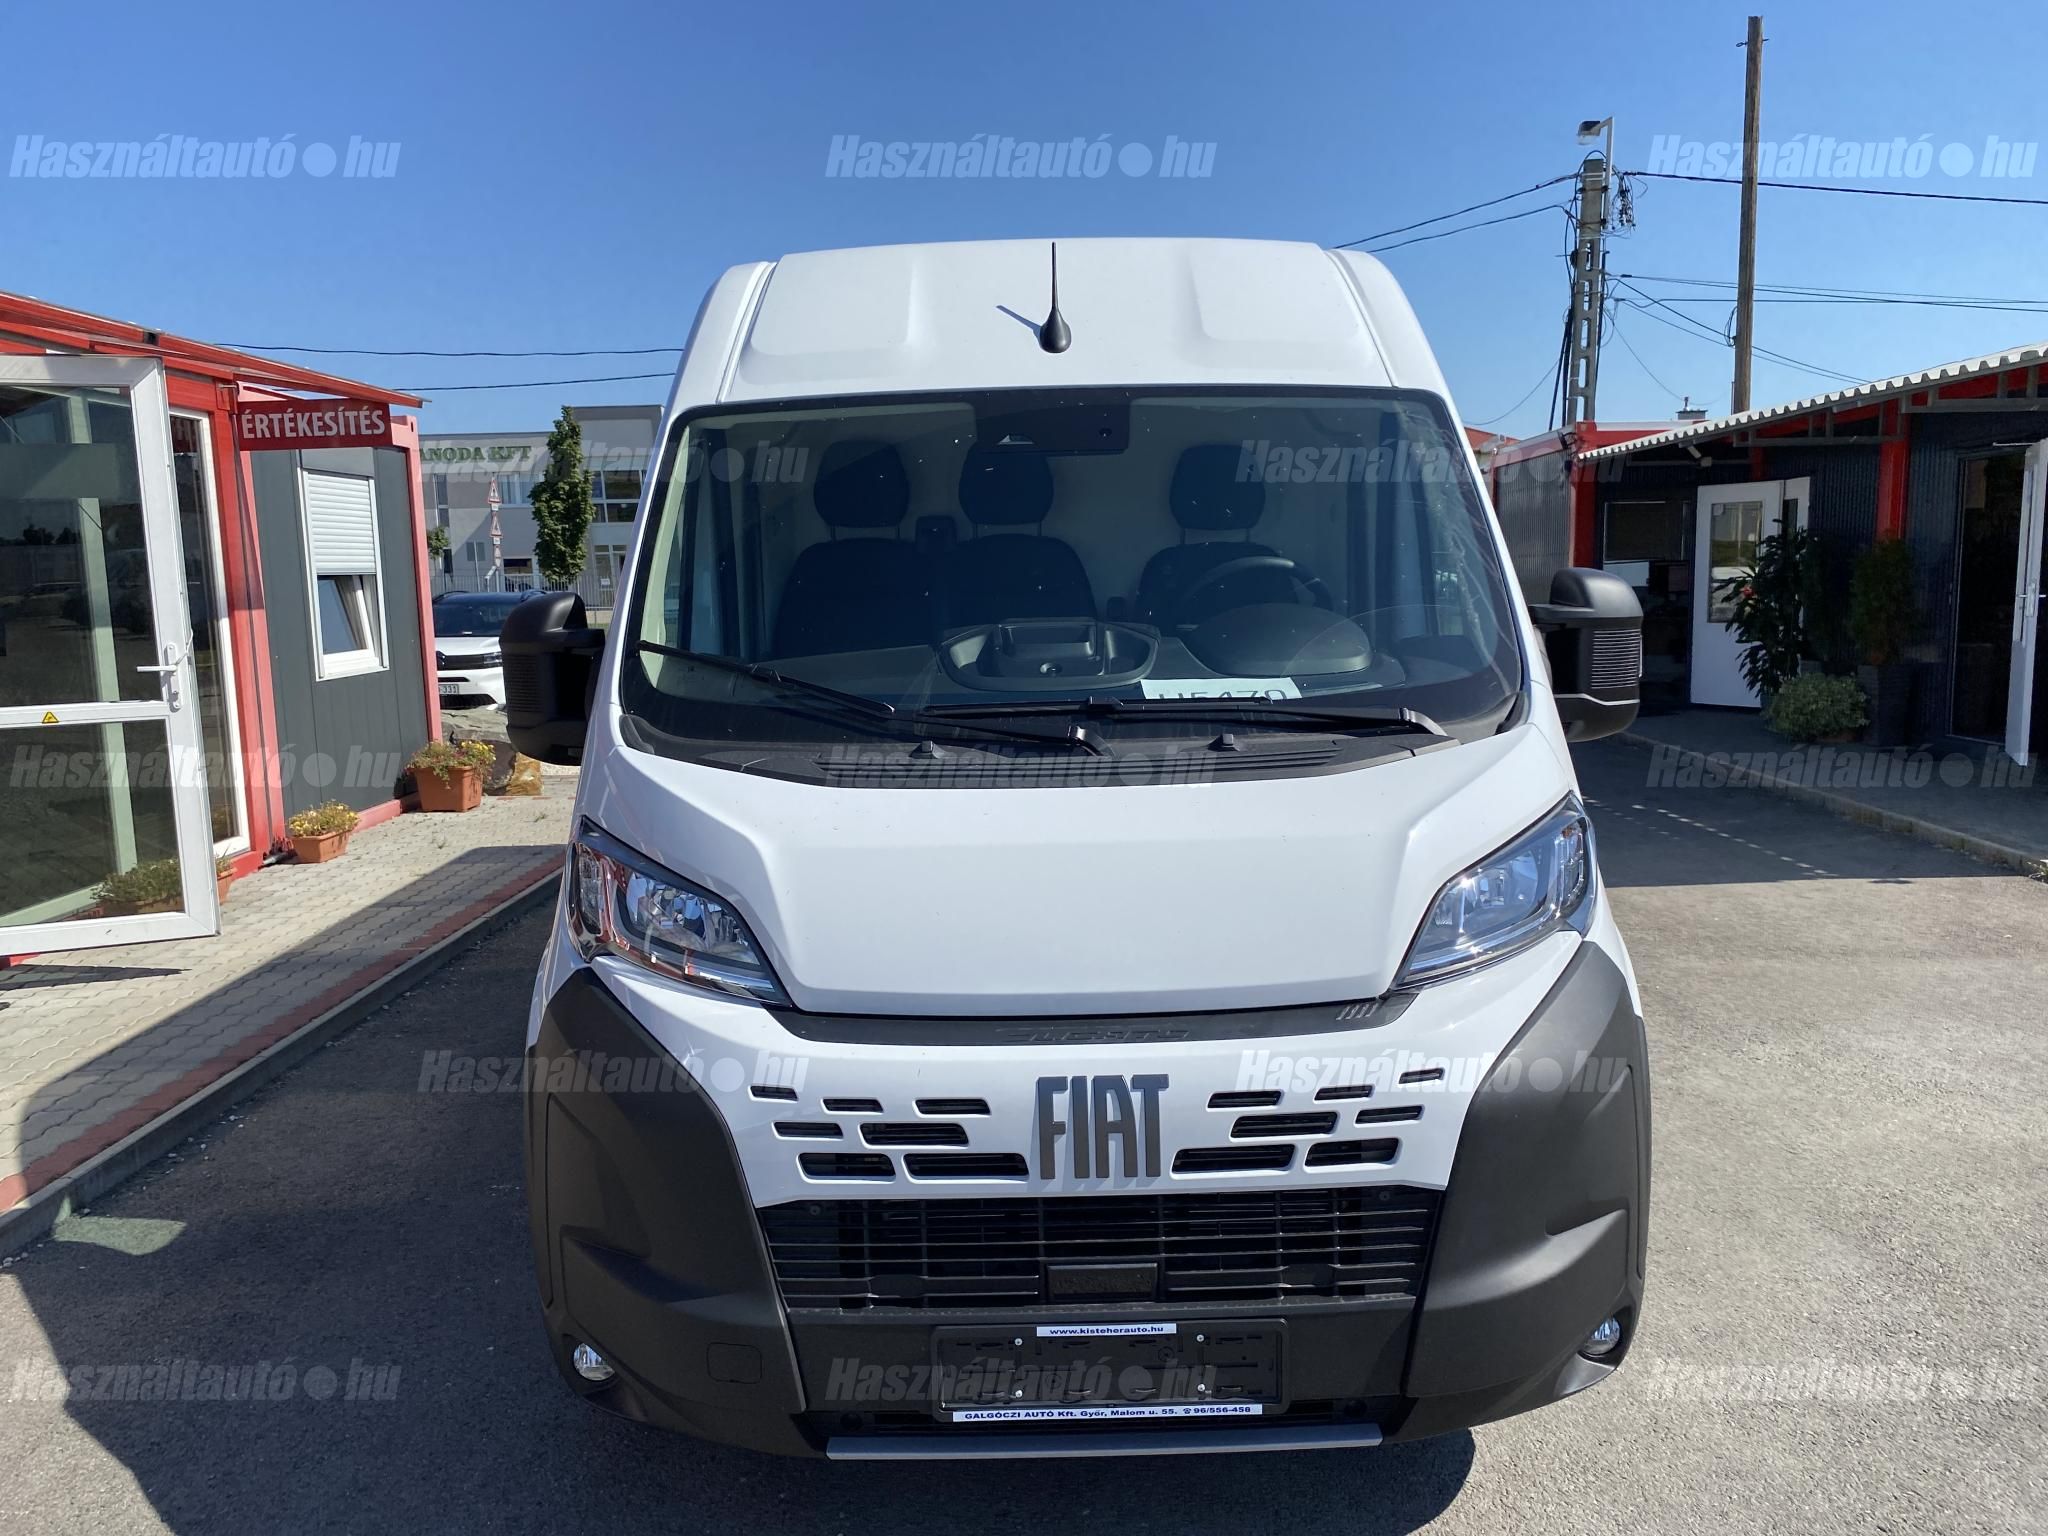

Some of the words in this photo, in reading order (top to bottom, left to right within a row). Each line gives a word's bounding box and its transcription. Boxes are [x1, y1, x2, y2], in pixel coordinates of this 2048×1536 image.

[242, 405, 385, 438] ÉRTÉKESÍTÉS
[489, 445, 532, 460] KFT
[1036, 1074, 1169, 1179] FIAT
[1050, 1325, 1164, 1335] www.kisteherauto.hu
[965, 1410, 1021, 1419] GALGÓCZI
[1024, 1409, 1055, 1418] AUTÓ
